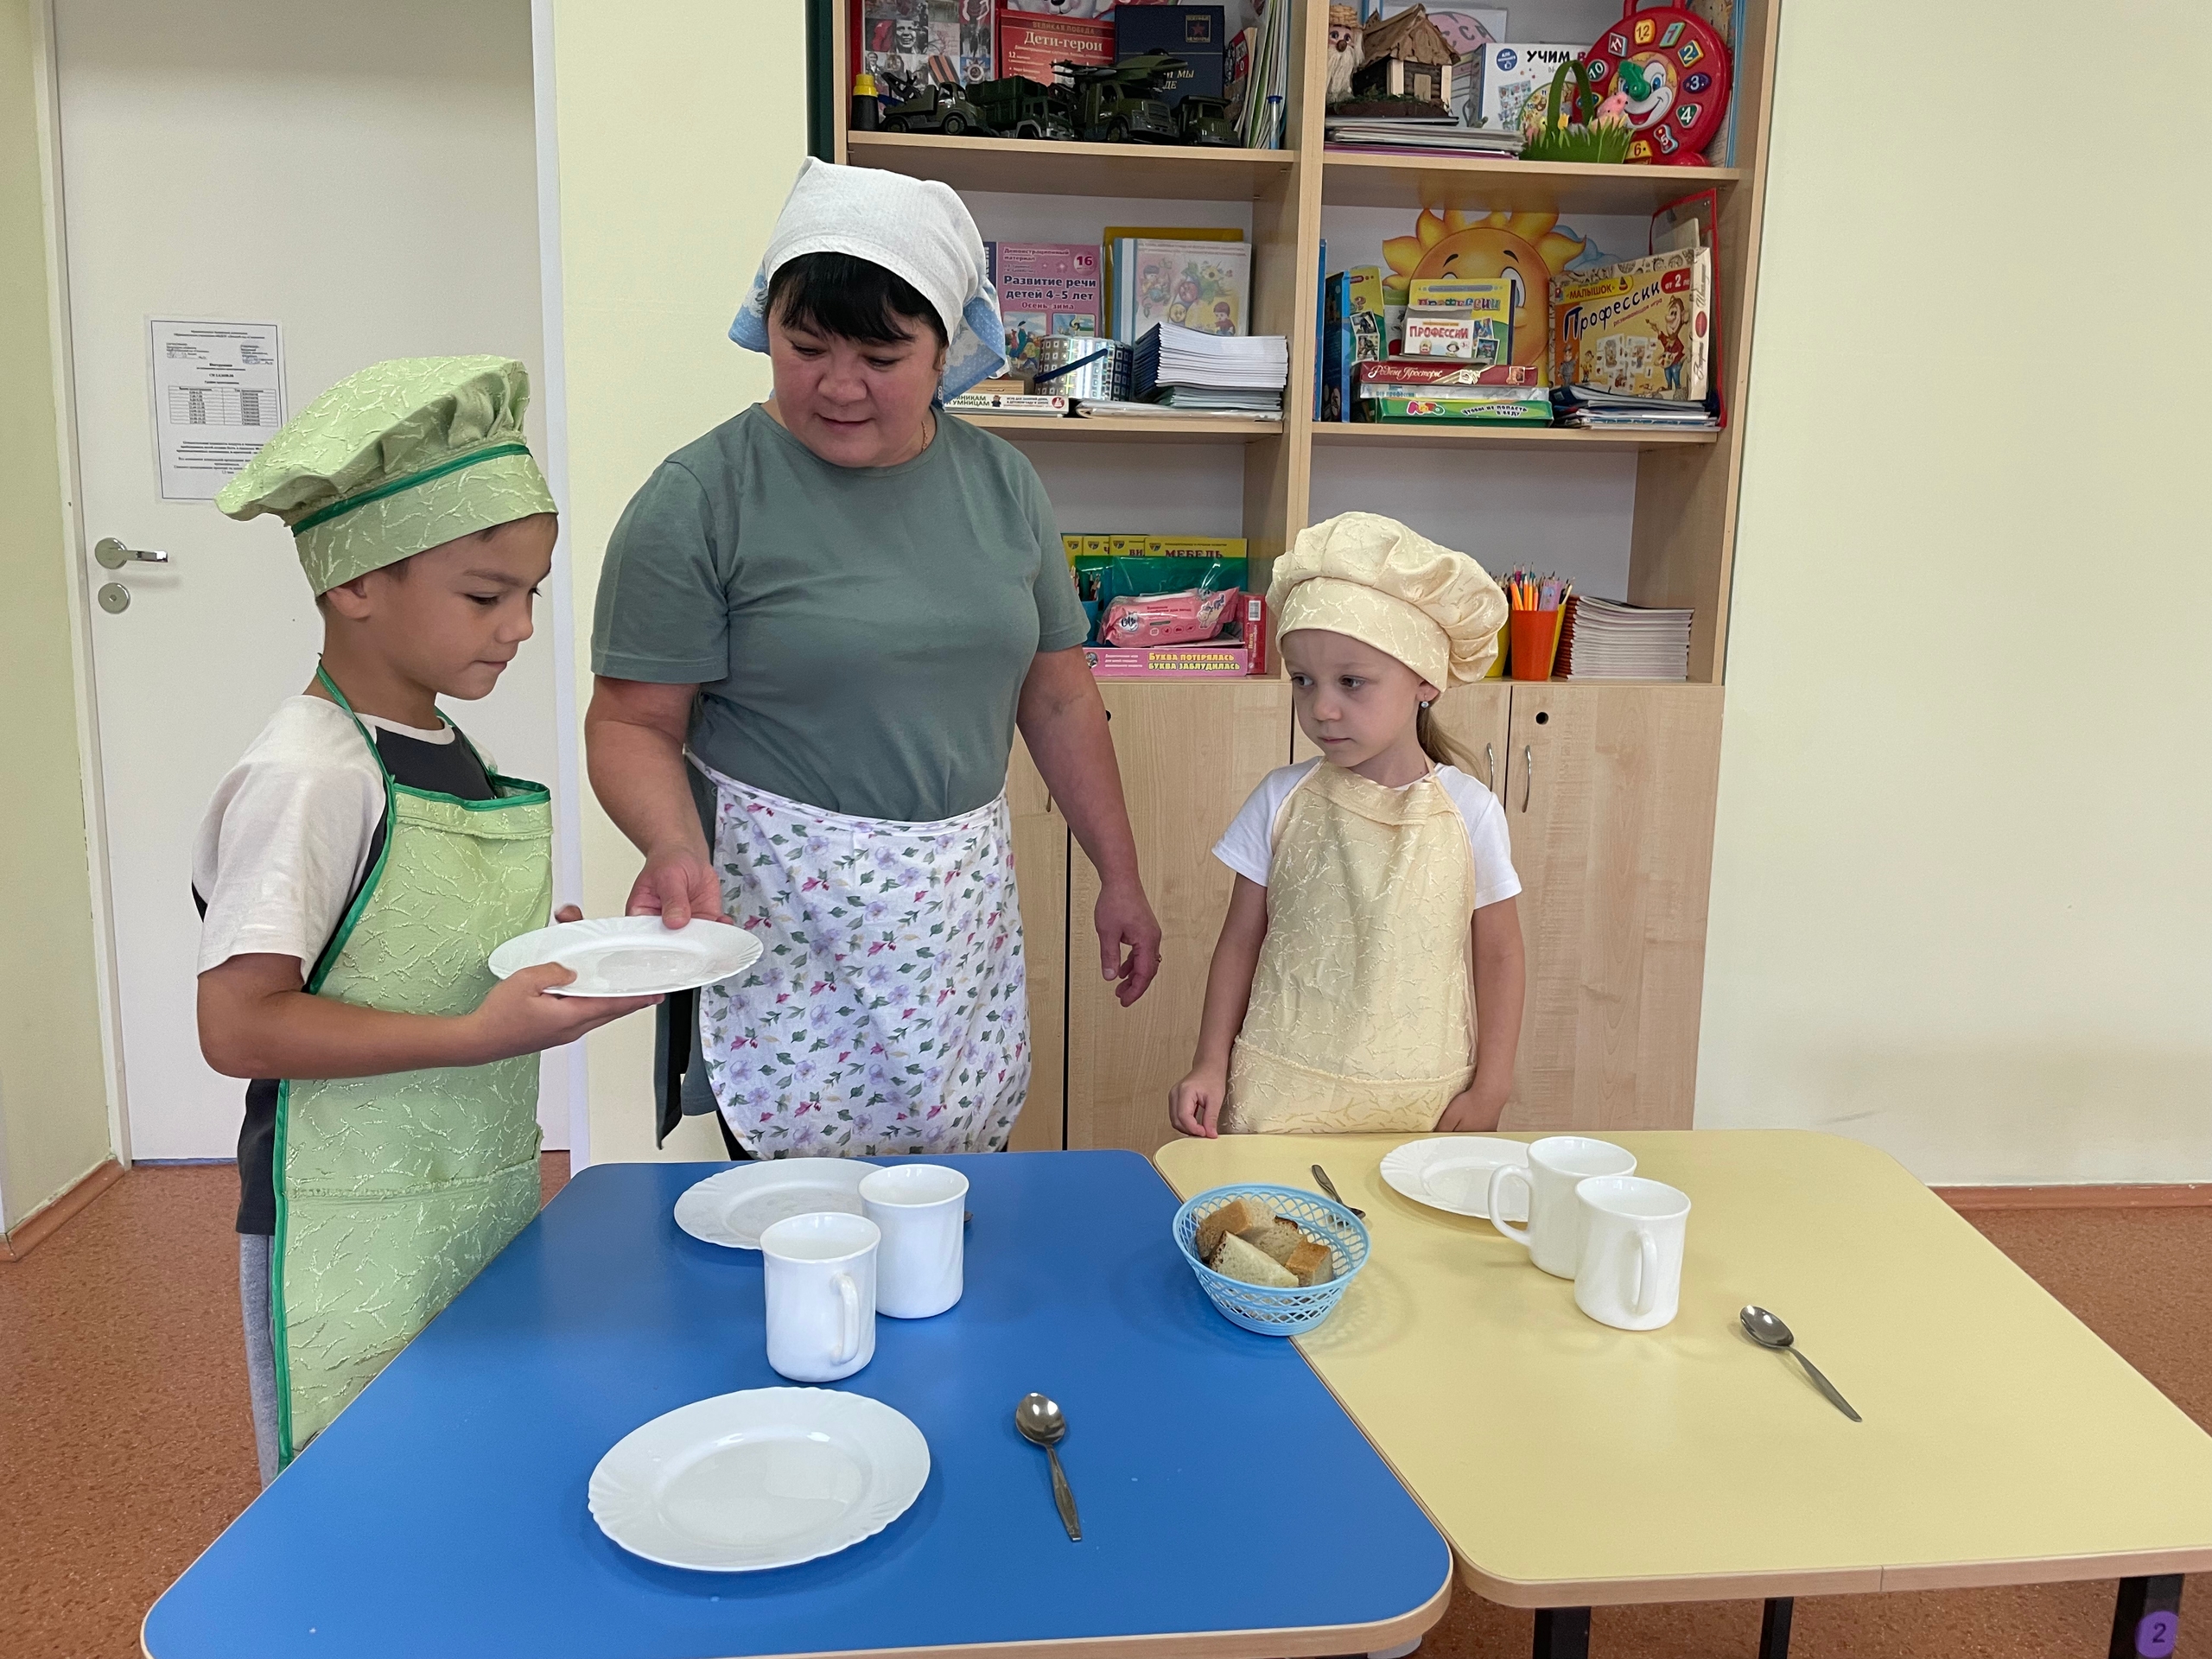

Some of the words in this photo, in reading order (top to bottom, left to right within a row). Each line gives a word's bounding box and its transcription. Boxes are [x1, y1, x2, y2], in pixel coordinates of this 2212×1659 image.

[1066, 25, 1095, 35] ПОБЕДА
[1636, 24, 1650, 39] 12
[1024, 31, 1103, 52] Дети-герои
[1526, 50, 1570, 64] УЧИМ
[1683, 44, 1694, 61] 2
[1177, 70, 1195, 79] МЫ
[1588, 62, 1604, 79] 10
[1690, 75, 1700, 91] 3
[1680, 106, 1692, 124] 4
[1660, 134, 1669, 146] 5
[1634, 143, 1642, 156] 6
[1076, 256, 1093, 266] 16
[1004, 276, 1063, 286] Развитие
[1066, 279, 1096, 289] речи
[1675, 275, 1681, 288] 2
[1006, 289, 1042, 299] детей
[1071, 292, 1094, 301] лет
[1563, 281, 1661, 342] Профессии
[1409, 325, 1469, 340] ПРОФЕССИИ
[1179, 664, 1241, 672] ЗАБЛУДИЛАСЬ
[2152, 1622, 2167, 1643] 2
